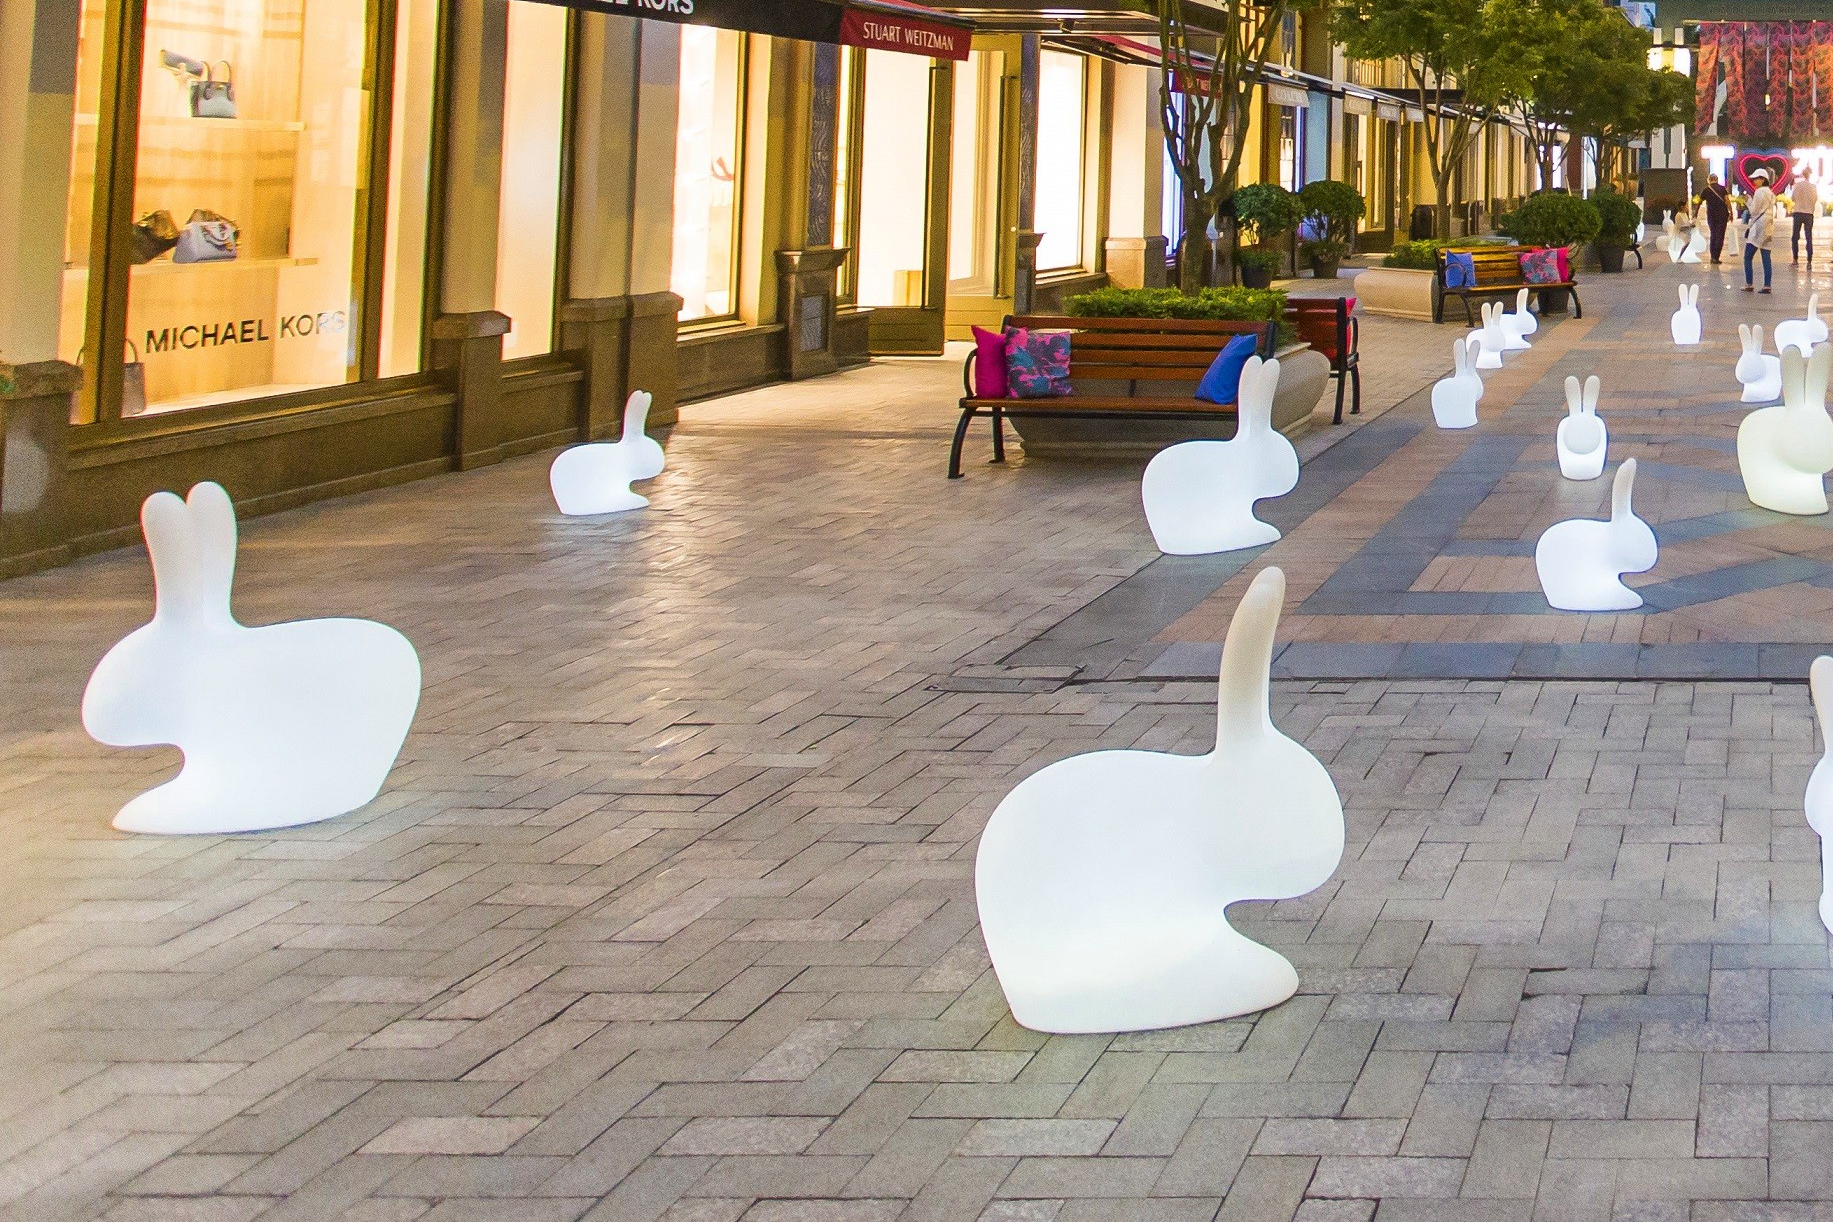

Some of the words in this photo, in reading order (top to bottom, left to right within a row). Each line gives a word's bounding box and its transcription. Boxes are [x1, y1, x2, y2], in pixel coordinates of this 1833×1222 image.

[863, 21, 901, 43] STUART
[904, 28, 954, 51] WEITZMAN
[145, 318, 269, 354] MICHAEL
[279, 310, 346, 339] KORS
